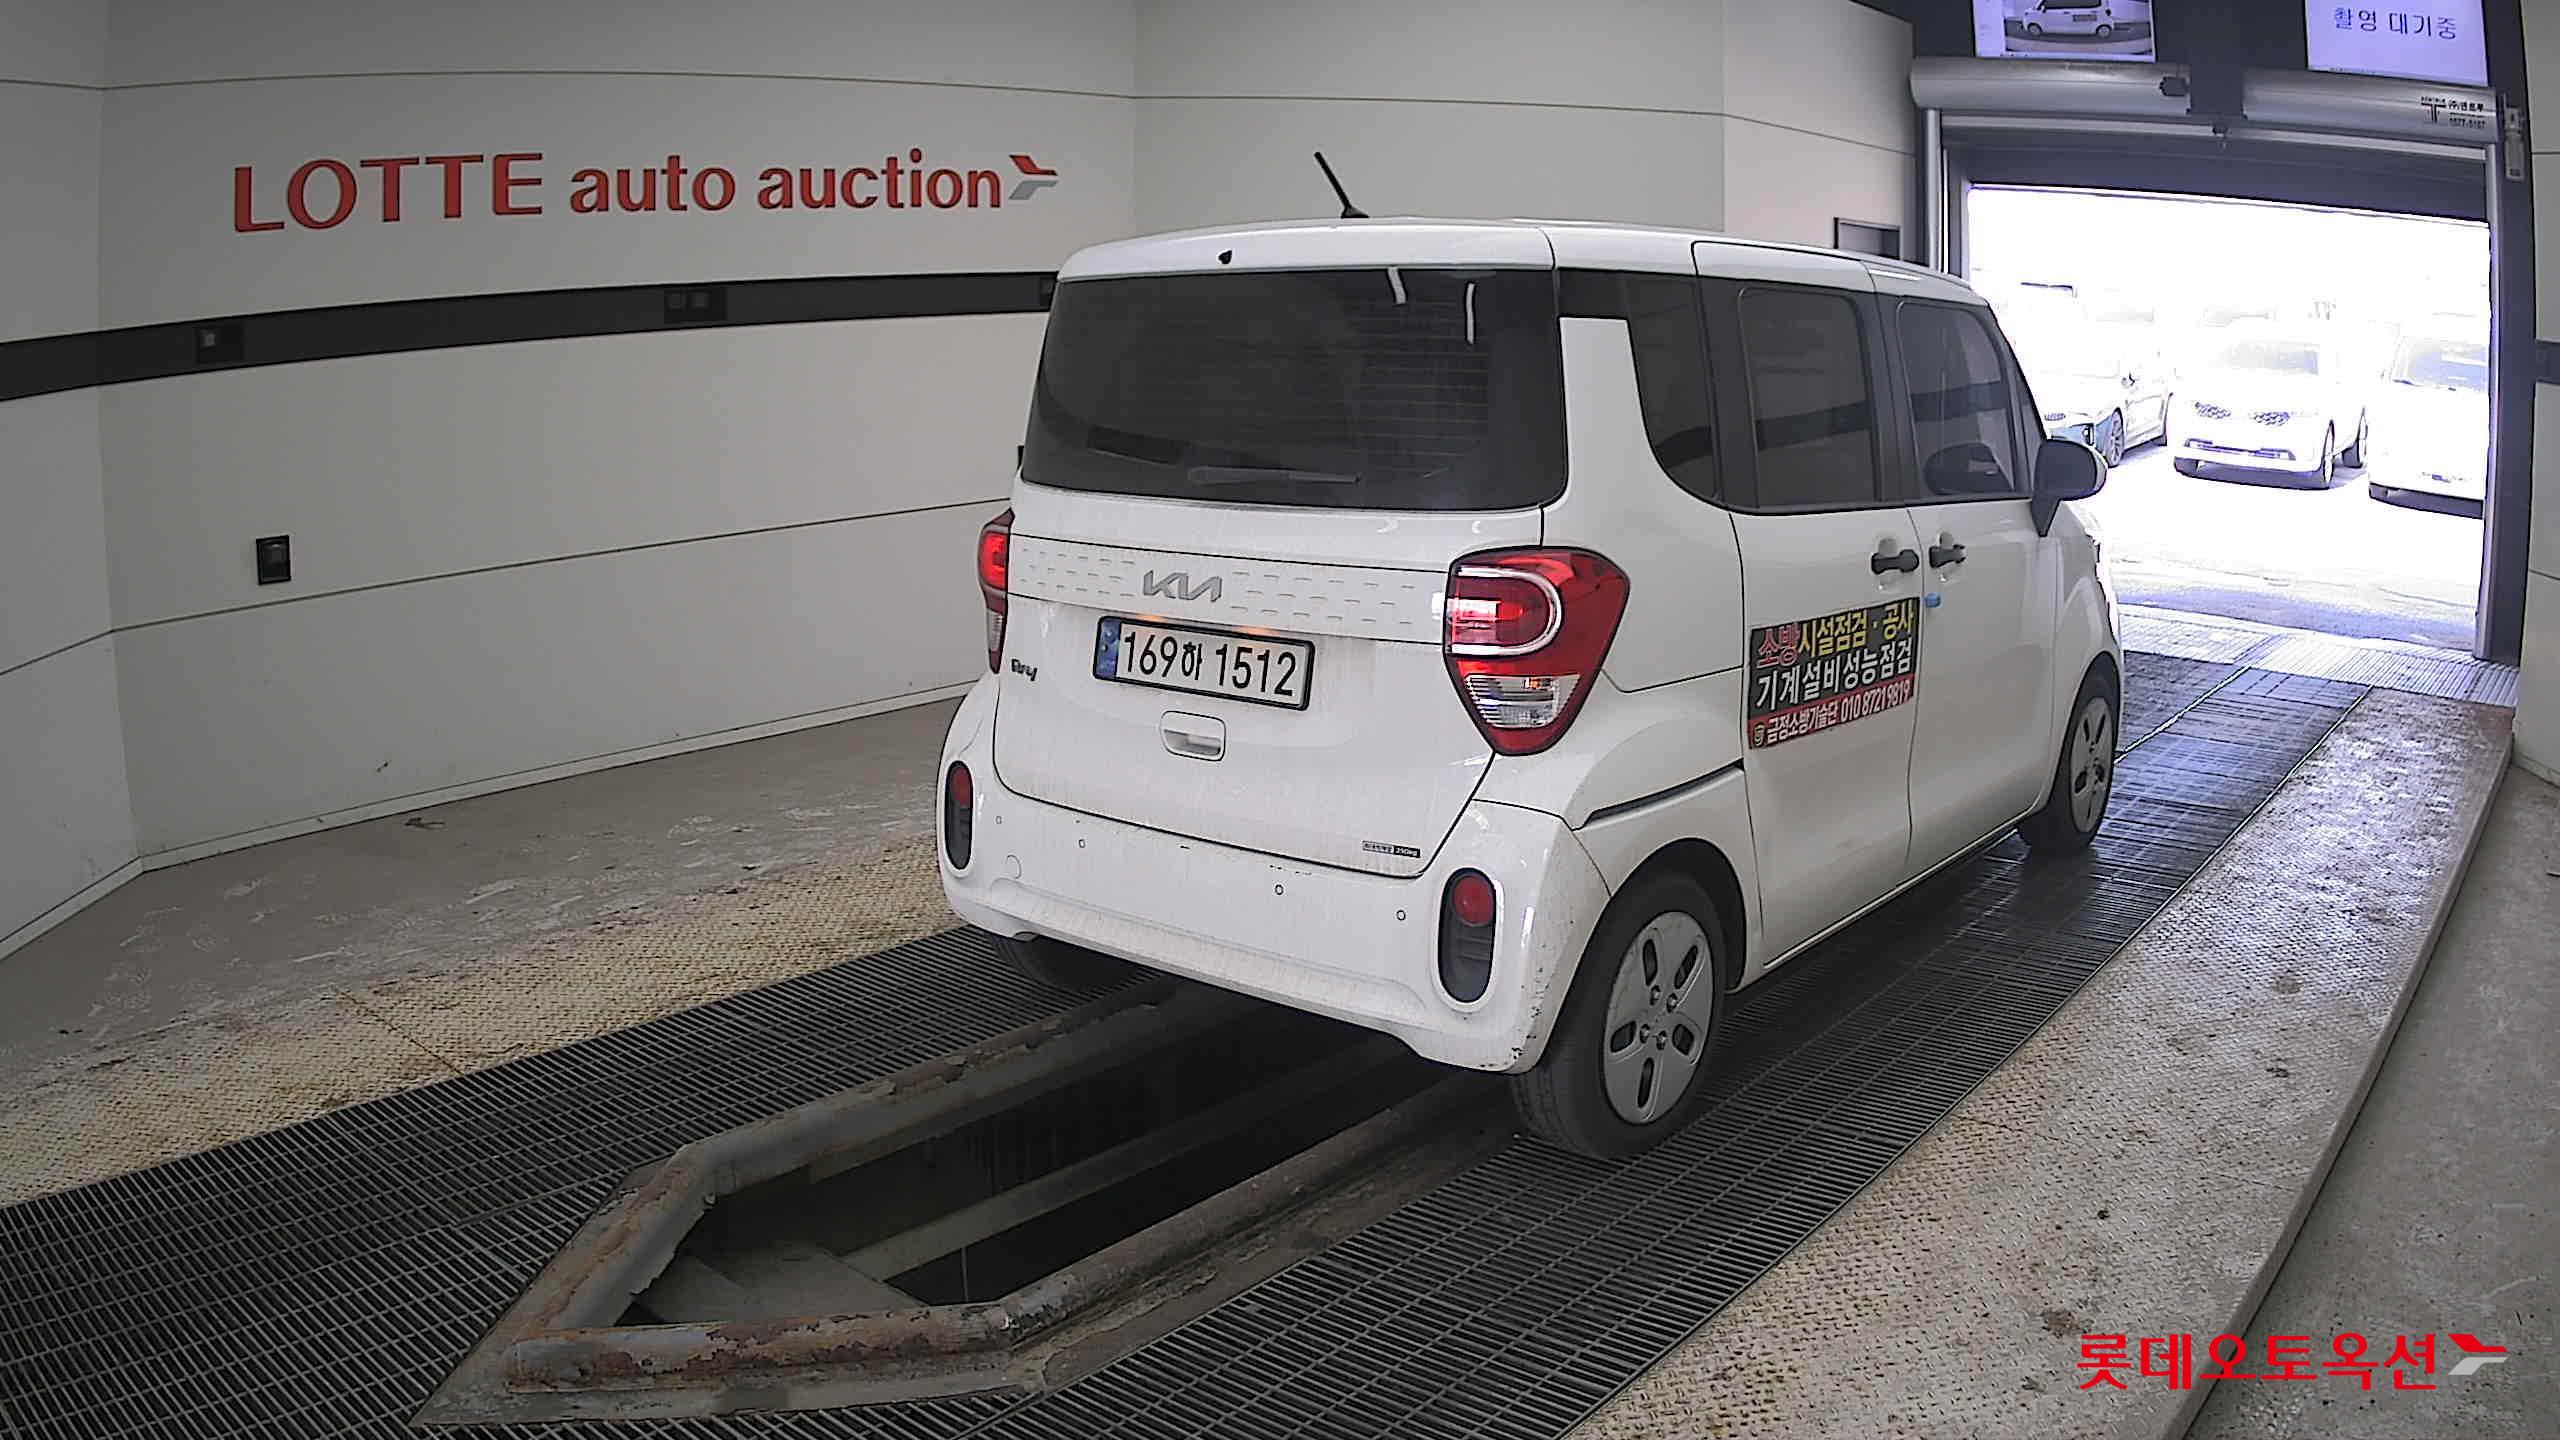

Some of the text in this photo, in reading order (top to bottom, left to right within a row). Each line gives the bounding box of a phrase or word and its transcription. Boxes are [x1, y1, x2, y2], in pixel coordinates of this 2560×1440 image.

[2389, 12, 2457, 40] 대기중
[234, 148, 1001, 233] LOTTE auto auction
[1124, 631, 1297, 696] 169하 1512
[1757, 610, 1868, 668] 소방시설점검
[1883, 599, 1914, 641] 공사
[1756, 637, 1913, 710] 기계설비성능점검
[1840, 694, 1861, 723] 010
